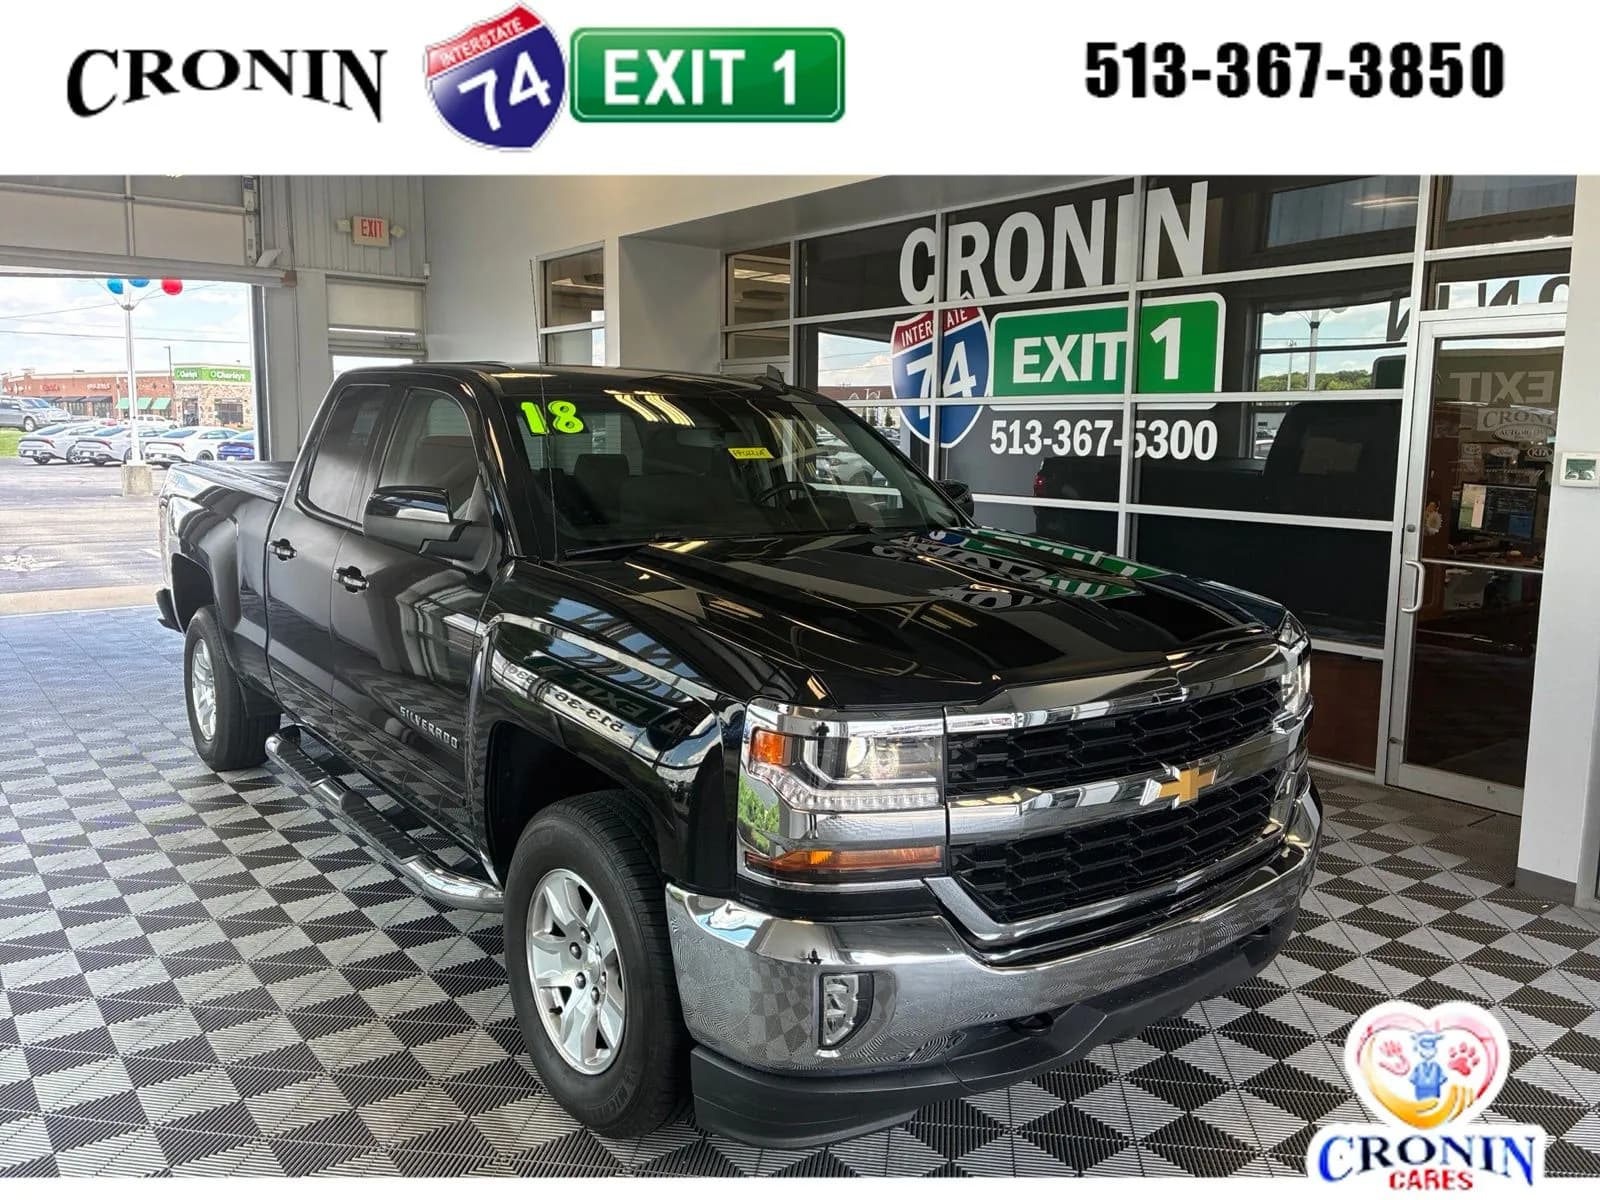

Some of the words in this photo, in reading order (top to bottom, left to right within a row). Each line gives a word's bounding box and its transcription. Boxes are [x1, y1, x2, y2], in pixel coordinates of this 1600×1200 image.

[360, 218, 384, 238] EXIT
[899, 181, 1209, 306] CRONIN
[900, 308, 968, 348] INTERATE
[1012, 330, 1130, 385] EXIT
[1149, 317, 1182, 381] 1
[906, 340, 977, 420] 74
[520, 401, 585, 435] 18
[989, 419, 1218, 461] 513-367-5300
[1531, 446, 1549, 458] KIA
[399, 705, 459, 750] SILVERADO
